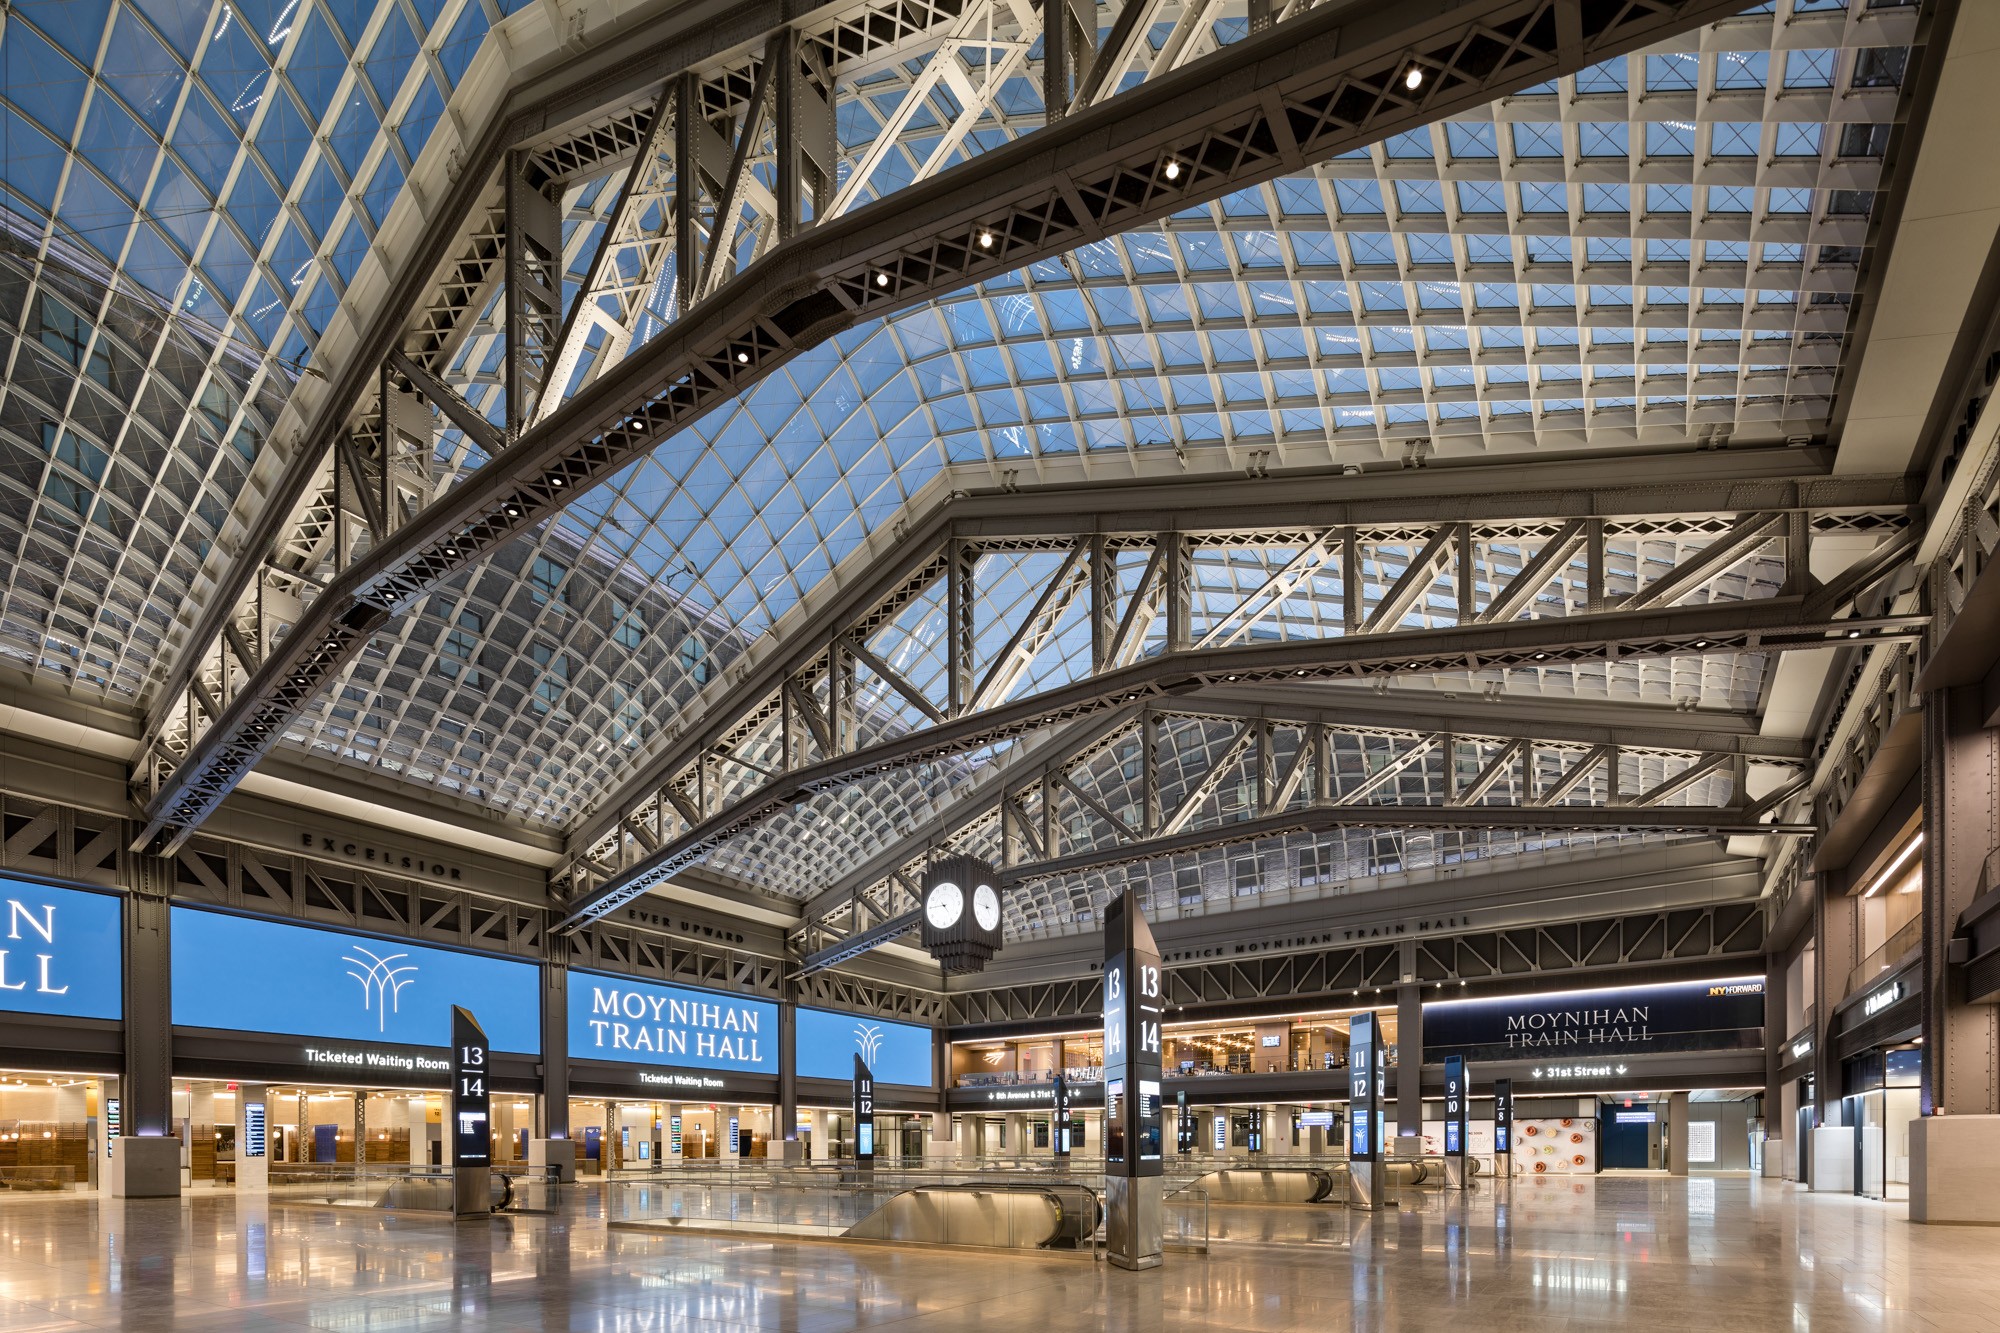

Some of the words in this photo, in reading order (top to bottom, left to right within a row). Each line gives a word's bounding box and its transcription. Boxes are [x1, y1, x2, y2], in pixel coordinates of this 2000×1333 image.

[302, 833, 462, 880] EXCELSIOR
[629, 909, 670, 927] EVER
[681, 922, 744, 943] UPWARD
[1163, 948, 1223, 962] ATRICK
[1235, 934, 1331, 953] MOYNIHAN
[1344, 924, 1404, 940] TRAIN
[1419, 916, 1470, 931] HALL
[1108, 968, 1120, 1002] 13
[1141, 964, 1158, 998] 13
[592, 987, 758, 1034] MOYNIHAN
[1507, 1006, 1648, 1030] MOYNIHAN
[589, 1020, 686, 1054] TRAIN
[696, 1032, 763, 1062] HALL
[1108, 1022, 1120, 1056] 14
[1141, 1020, 1159, 1053] 14
[1504, 1030, 1578, 1048] TRAIN
[1588, 1026, 1654, 1043] HALL
[306, 1049, 363, 1064] Ticketed
[366, 1054, 413, 1069] Waiting
[416, 1058, 450, 1070] Room
[462, 1046, 483, 1065] 13
[1355, 1050, 1364, 1068] 11
[640, 1073, 673, 1084] Ticketed
[674, 1075, 702, 1087] Waiting
[703, 1078, 724, 1087] Room
[1548, 1067, 1572, 1077] 31st
[1574, 1066, 1610, 1076] Street
[461, 1078, 484, 1097] 14
[861, 1080, 870, 1092] 11
[1354, 1080, 1366, 1097] 12
[1450, 1081, 1456, 1093] 9
[861, 1101, 872, 1113] 12
[1064, 1097, 1068, 1105] 9
[1448, 1101, 1458, 1113] 10
[1498, 1097, 1504, 1106] 7
[1498, 1112, 1504, 1121] 8
